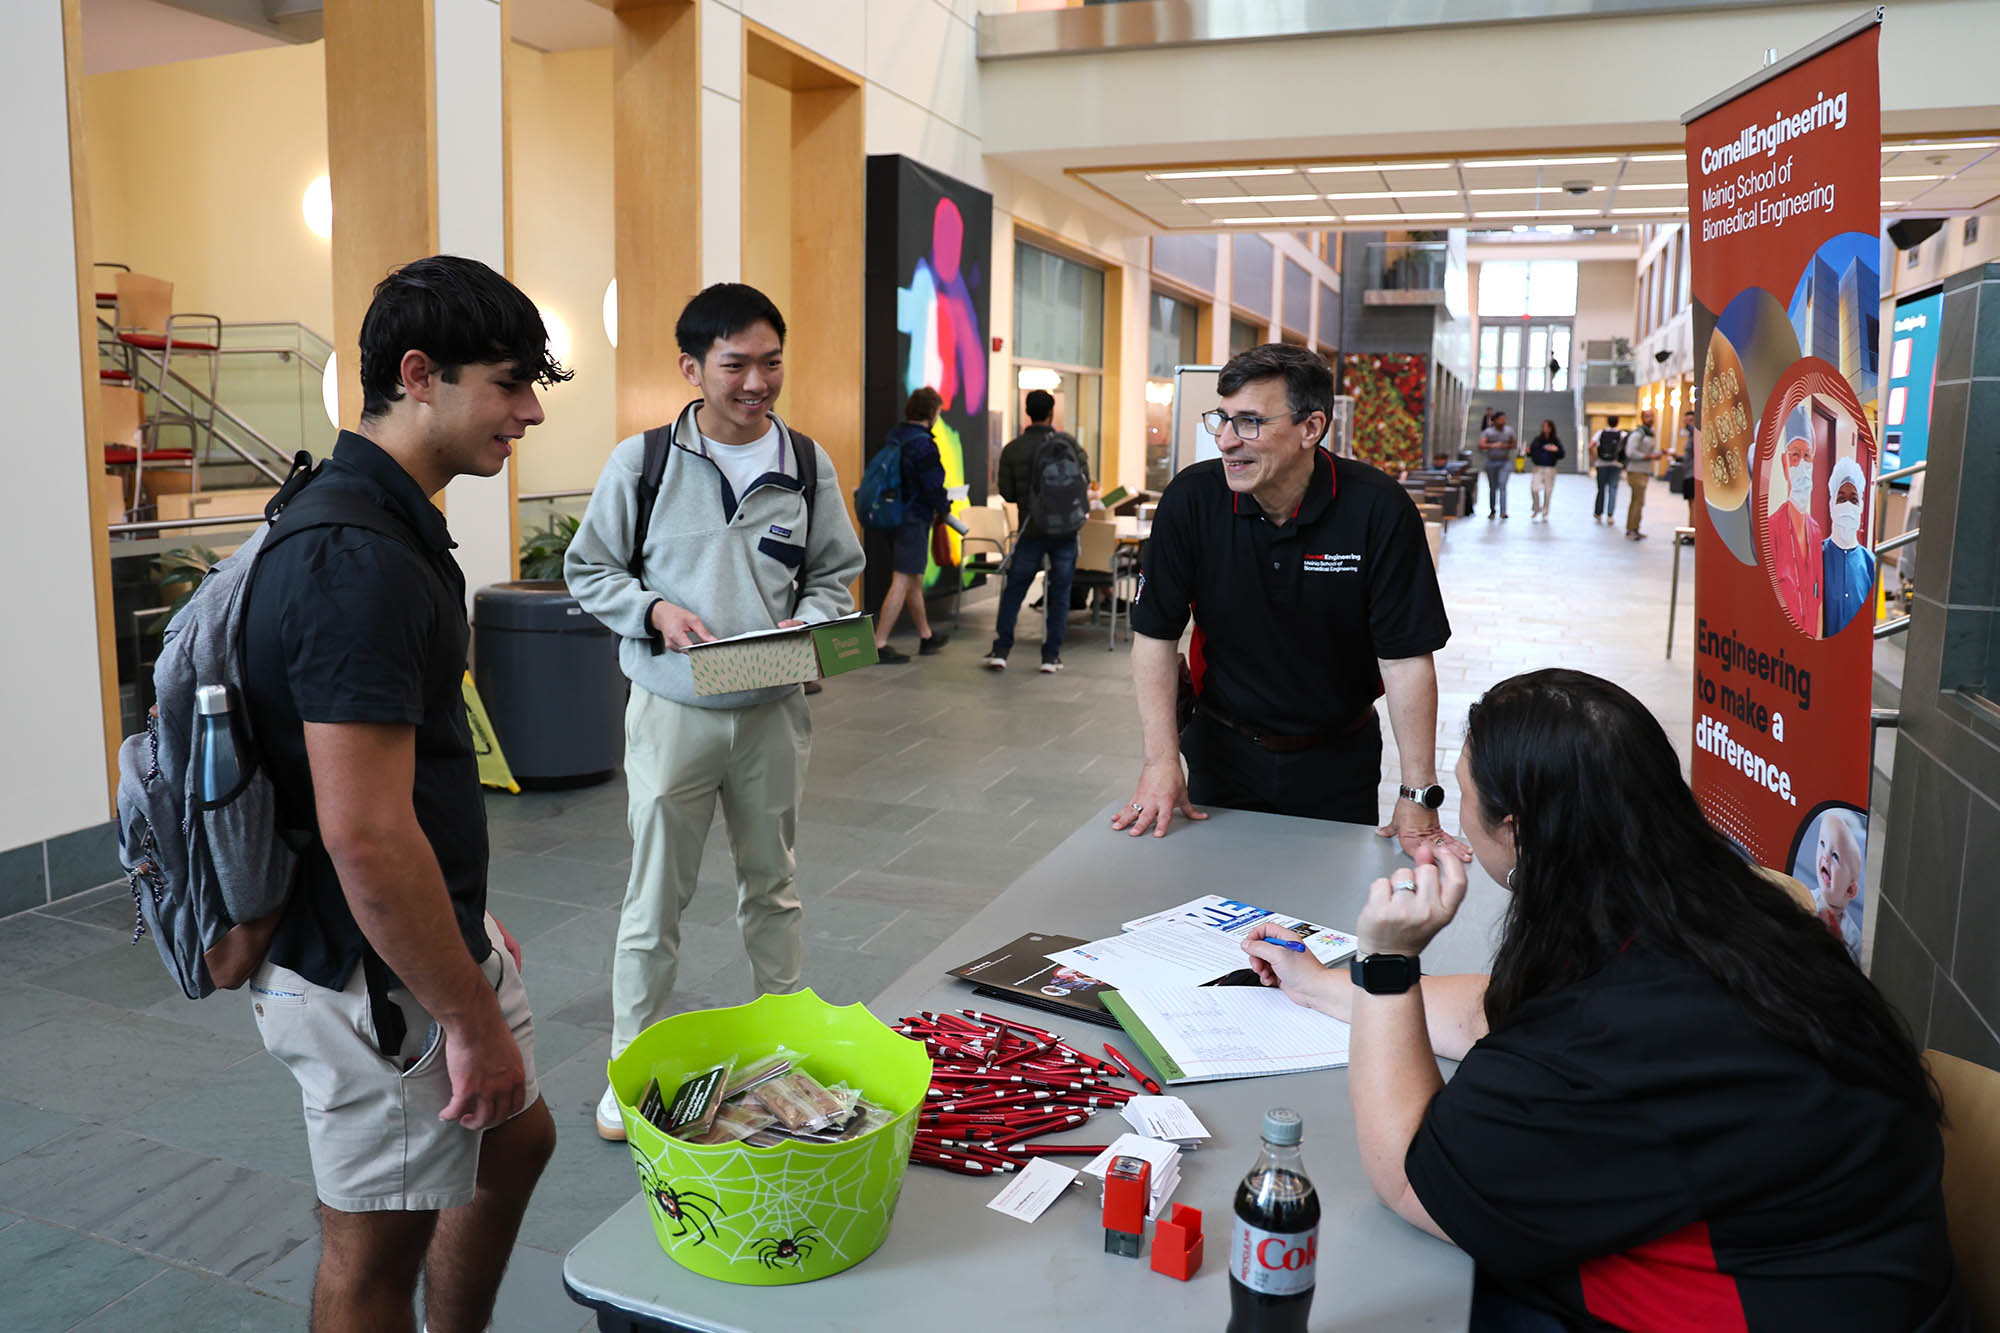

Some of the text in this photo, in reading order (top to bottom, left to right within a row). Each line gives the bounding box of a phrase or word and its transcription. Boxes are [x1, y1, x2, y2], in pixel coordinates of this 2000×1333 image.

[1701, 91, 1847, 175] CornellEngineering
[1702, 155, 1793, 212] Meinig School of
[1703, 182, 1835, 242] Biomedical Engineering
[1697, 618, 1811, 711] Engineering
[1697, 669, 1784, 742] to make a
[1696, 714, 1796, 806] difference.
